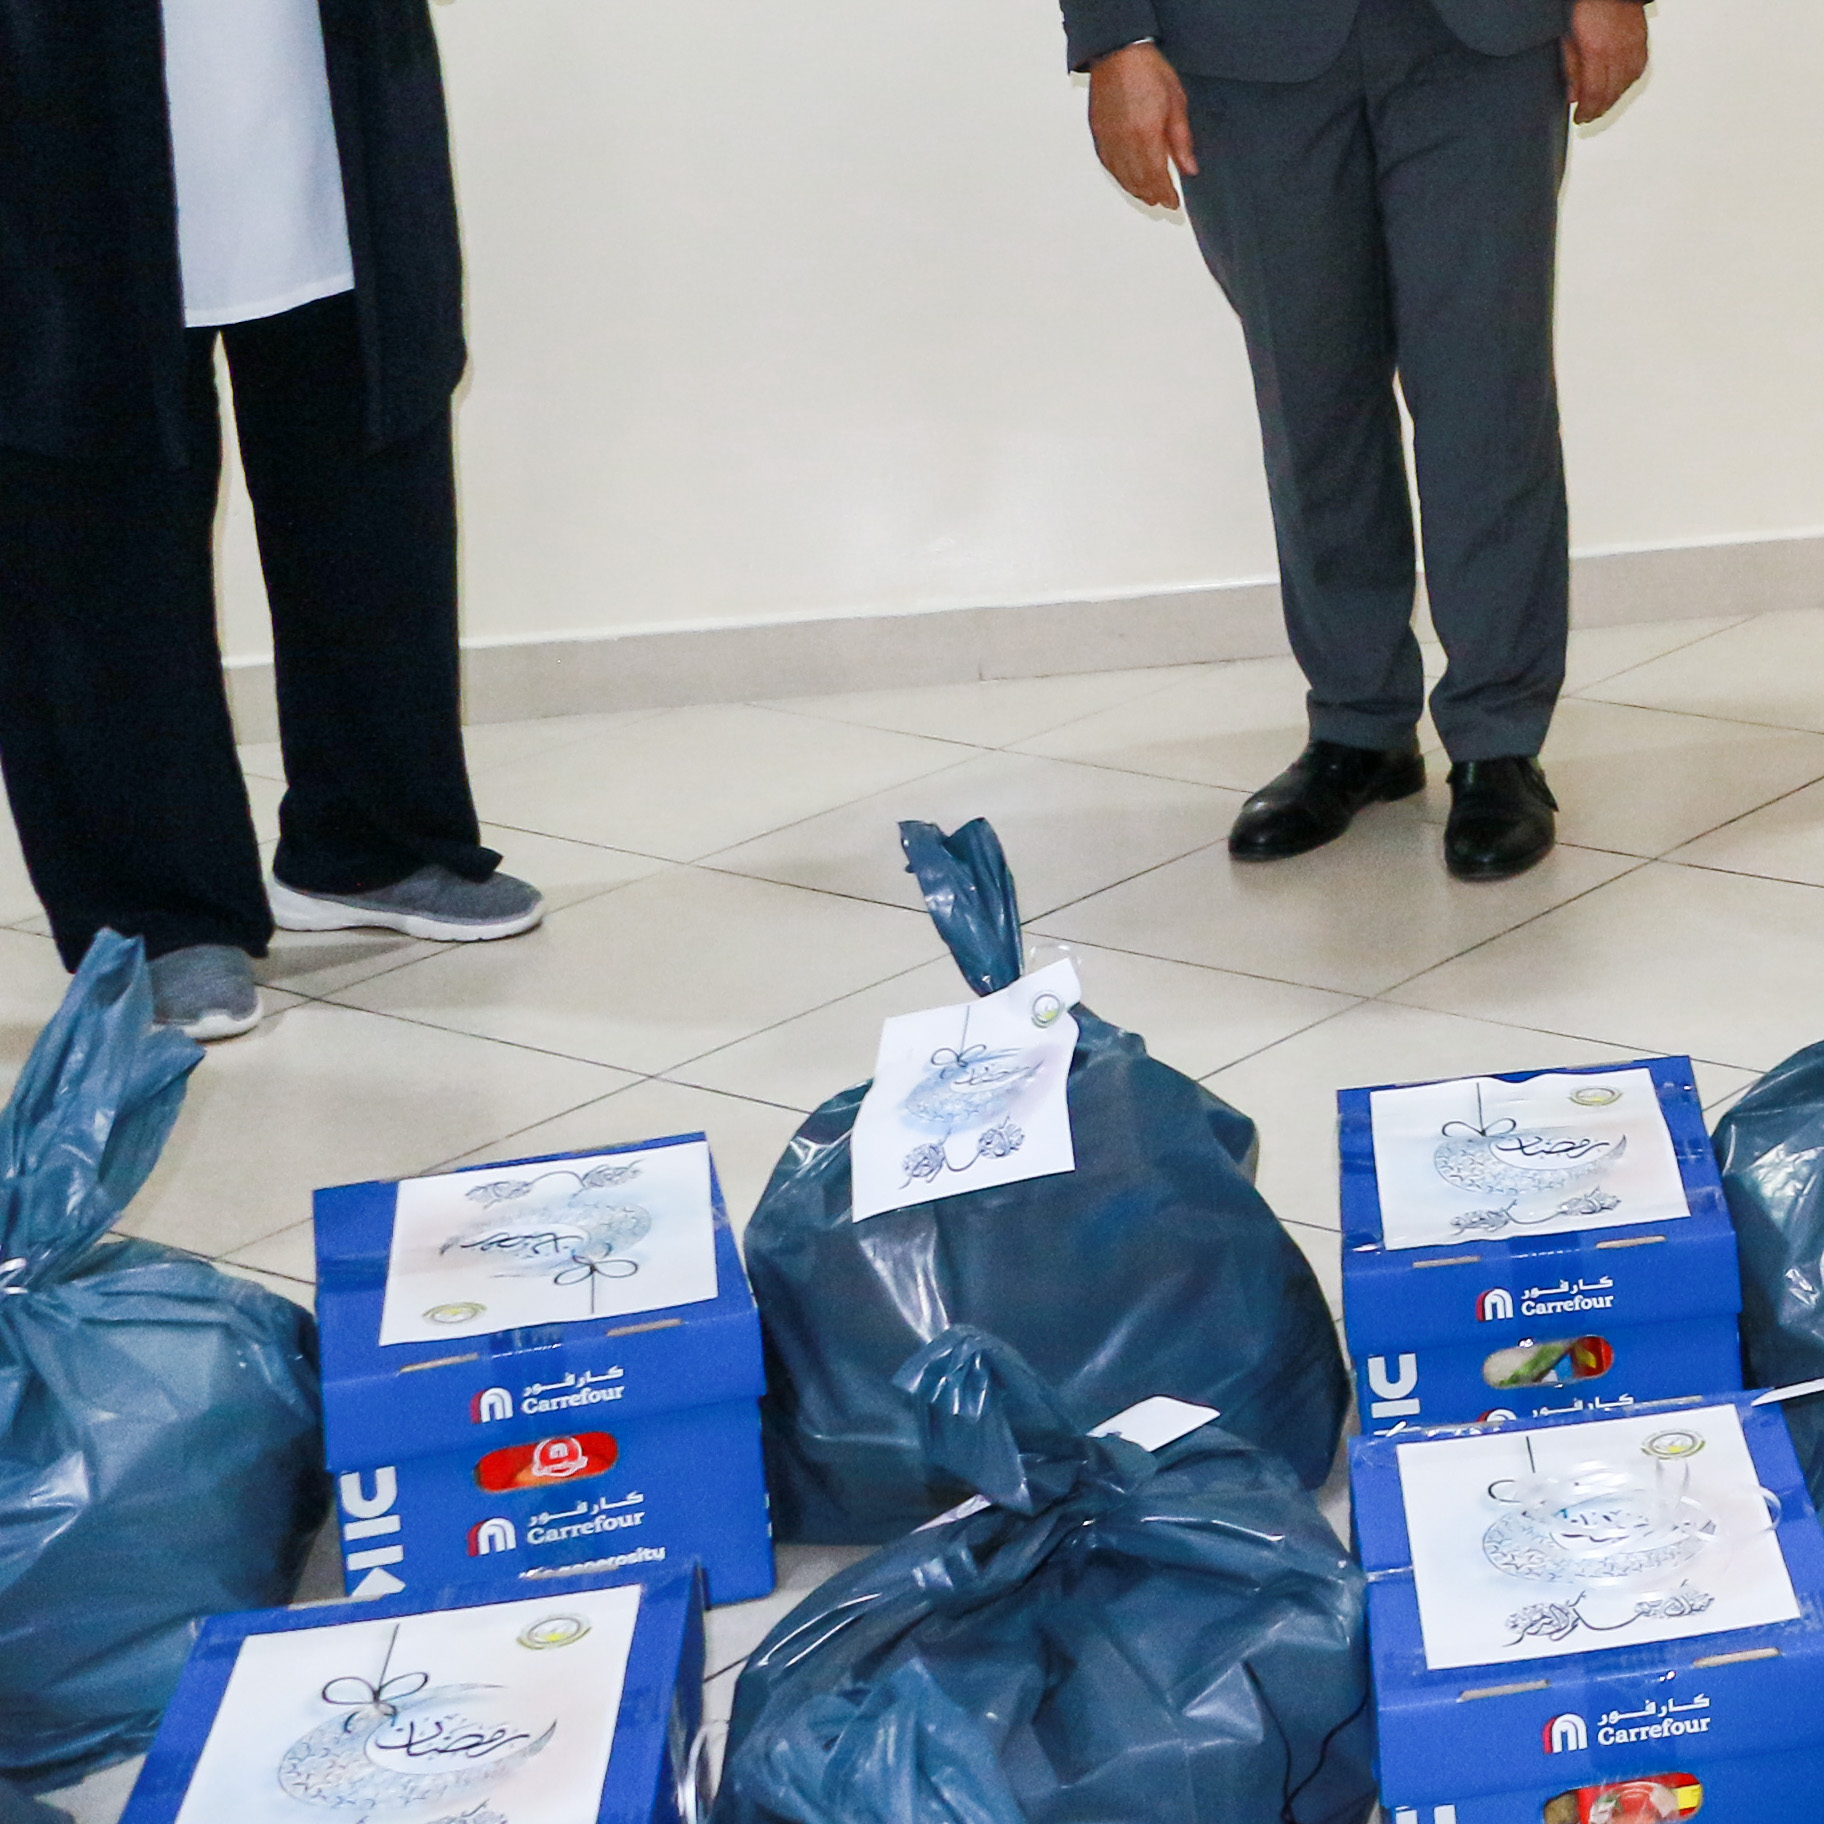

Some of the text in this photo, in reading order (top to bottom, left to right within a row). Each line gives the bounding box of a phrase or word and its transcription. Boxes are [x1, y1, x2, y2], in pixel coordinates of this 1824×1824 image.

[1520, 1275, 1614, 1300] كارفور
[1520, 1293, 1615, 1317] Carrefour
[521, 1364, 625, 1398] كارفور
[520, 1385, 626, 1416] Carrefour
[528, 1490, 645, 1527] كارفور
[526, 1511, 646, 1546] Carrefour
[1597, 1692, 1711, 1726] كارفور
[1596, 1715, 1712, 1747] Carrefour
